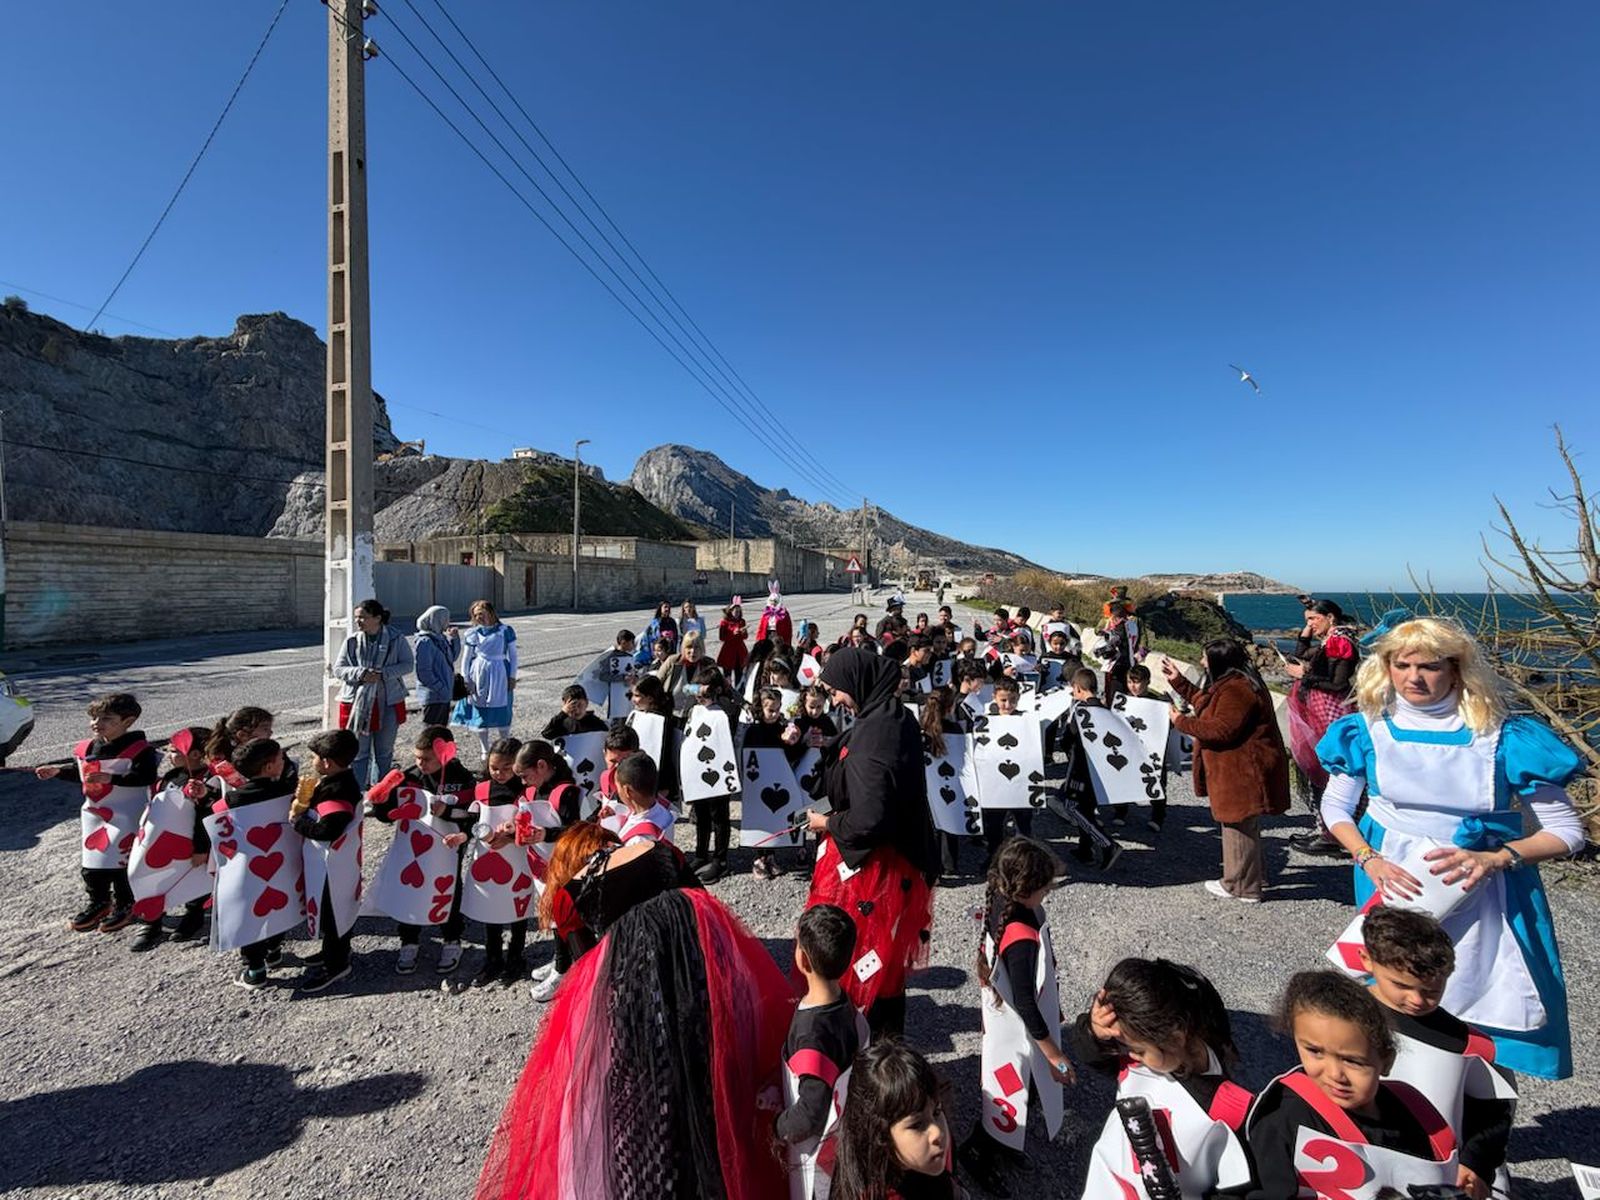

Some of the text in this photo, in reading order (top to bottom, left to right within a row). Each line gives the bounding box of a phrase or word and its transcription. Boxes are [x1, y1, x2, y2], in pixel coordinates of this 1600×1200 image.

[611, 658, 620, 669] 3
[935, 661, 944, 676] 2
[1114, 695, 1127, 711] 2
[974, 715, 990, 732] 2
[1077, 708, 1095, 729] 2
[746, 750, 760, 768] A
[725, 776, 737, 792] 3
[1141, 776, 1161, 798] 2
[1028, 785, 1046, 808] 2
[215, 815, 234, 838] 3
[964, 811, 981, 834] 2
[428, 894, 453, 923] 2
[513, 895, 532, 918] A
[992, 1097, 1017, 1133] 3
[1300, 1138, 1367, 1200] 2
